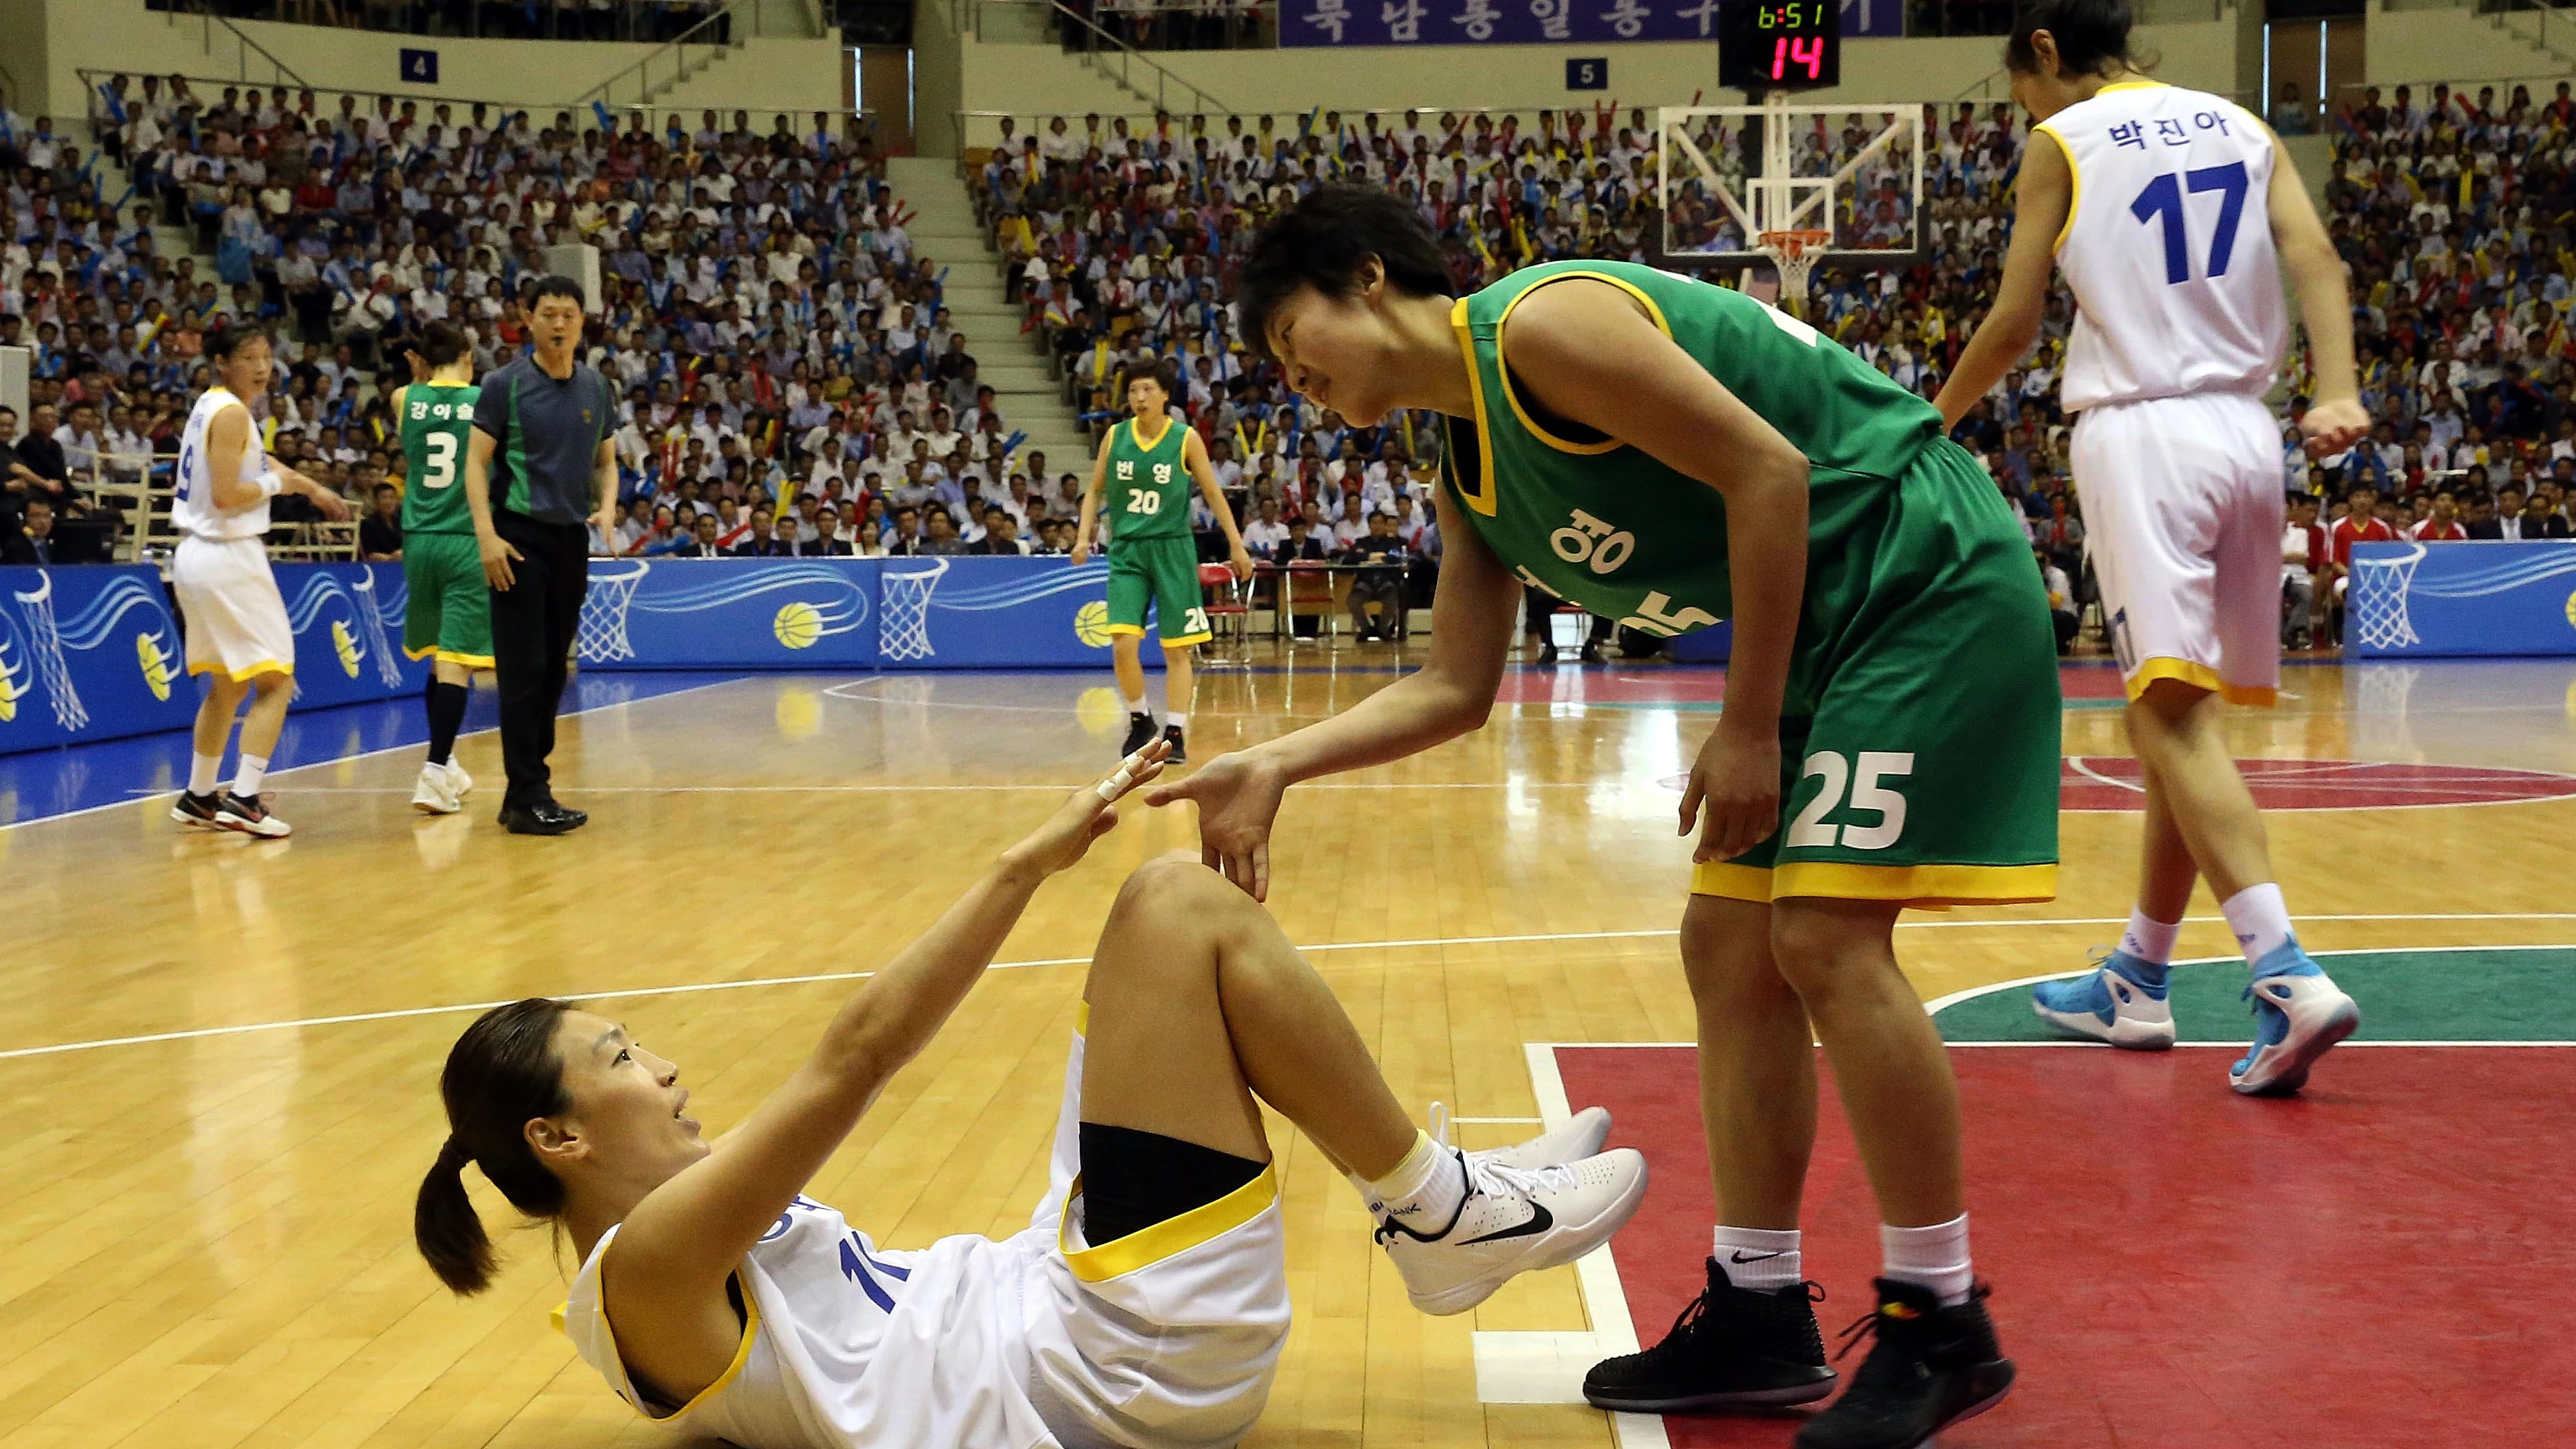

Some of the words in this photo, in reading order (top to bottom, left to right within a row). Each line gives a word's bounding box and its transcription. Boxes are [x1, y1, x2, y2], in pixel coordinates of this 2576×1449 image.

[1758, 3, 1823, 29] 6:51
[413, 56, 427, 77] 4
[1581, 63, 1594, 84] 5
[1772, 37, 1823, 79] 14
[2130, 161, 2249, 285] 17
[423, 431, 458, 489] 3
[1126, 488, 1161, 515] 20
[1786, 750, 1915, 850] 25
